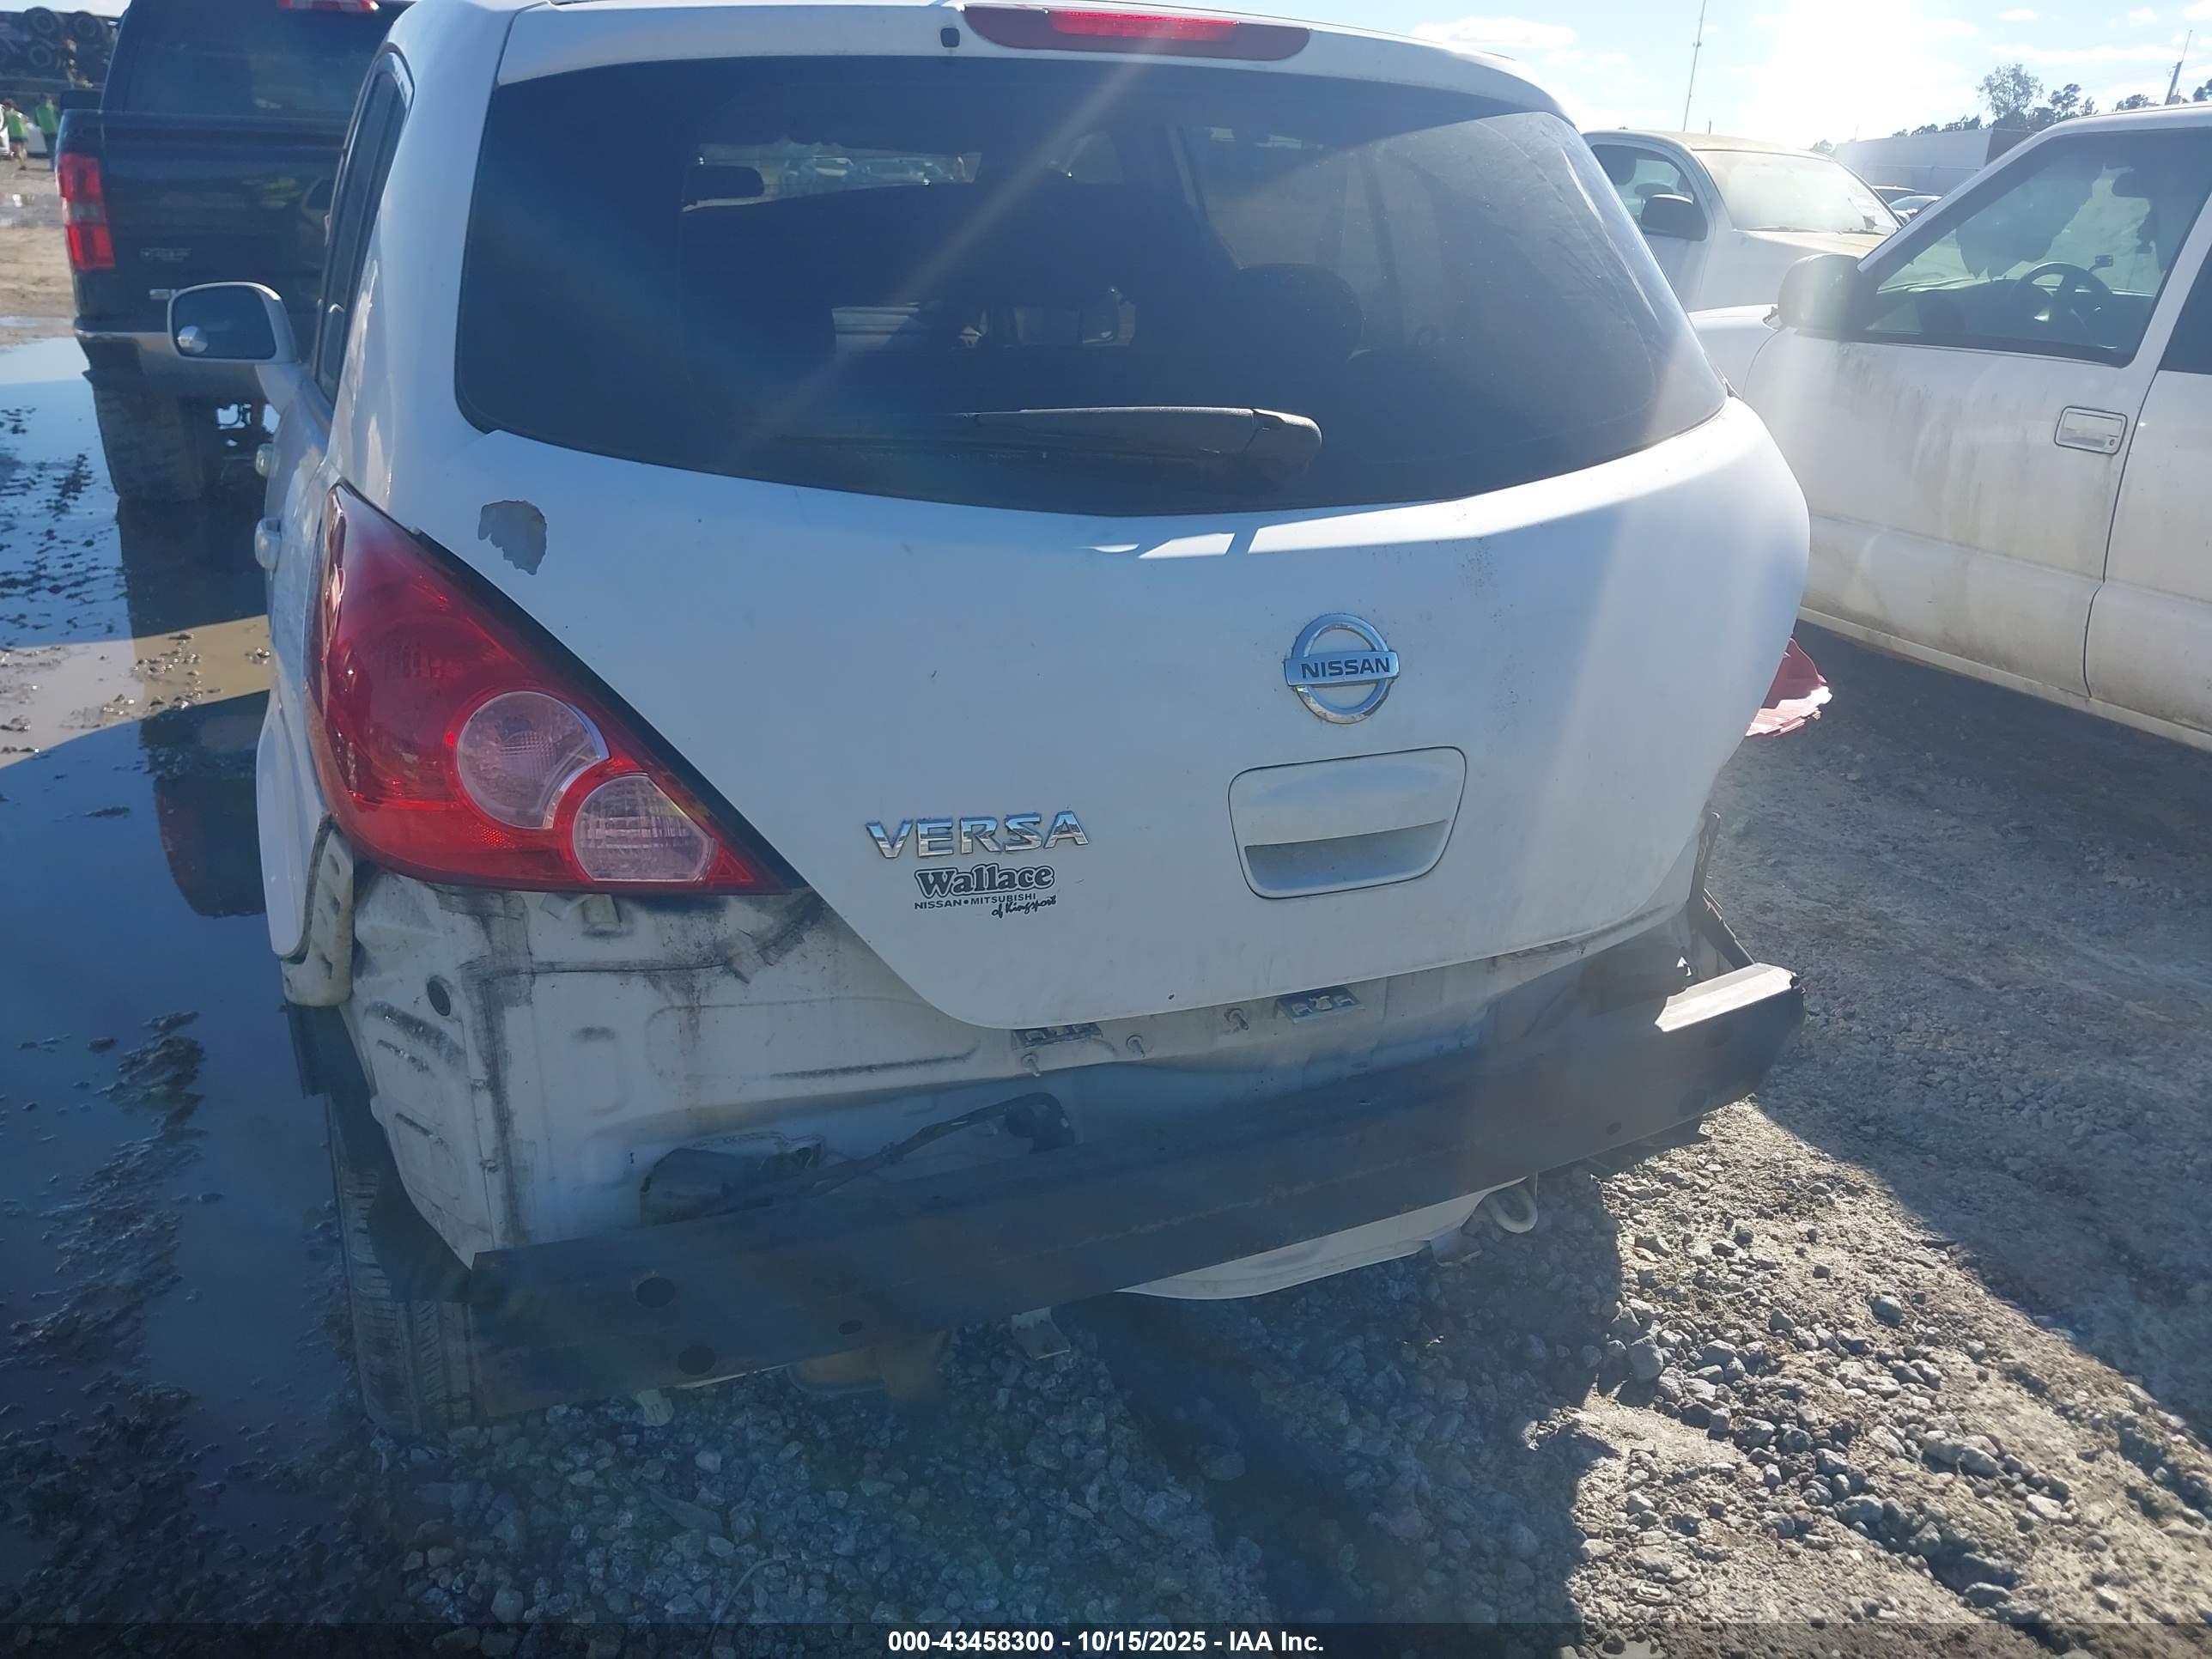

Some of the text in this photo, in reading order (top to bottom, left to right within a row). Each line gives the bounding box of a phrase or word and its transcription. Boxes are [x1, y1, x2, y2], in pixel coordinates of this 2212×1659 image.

[1301, 657, 1390, 678] NISSAN
[866, 811, 1089, 859] VERSA
[914, 863, 1055, 899] Wallace
[915, 893, 1036, 909] NISSAN MITSUBISHI
[991, 895, 1057, 919] of Kingsport
